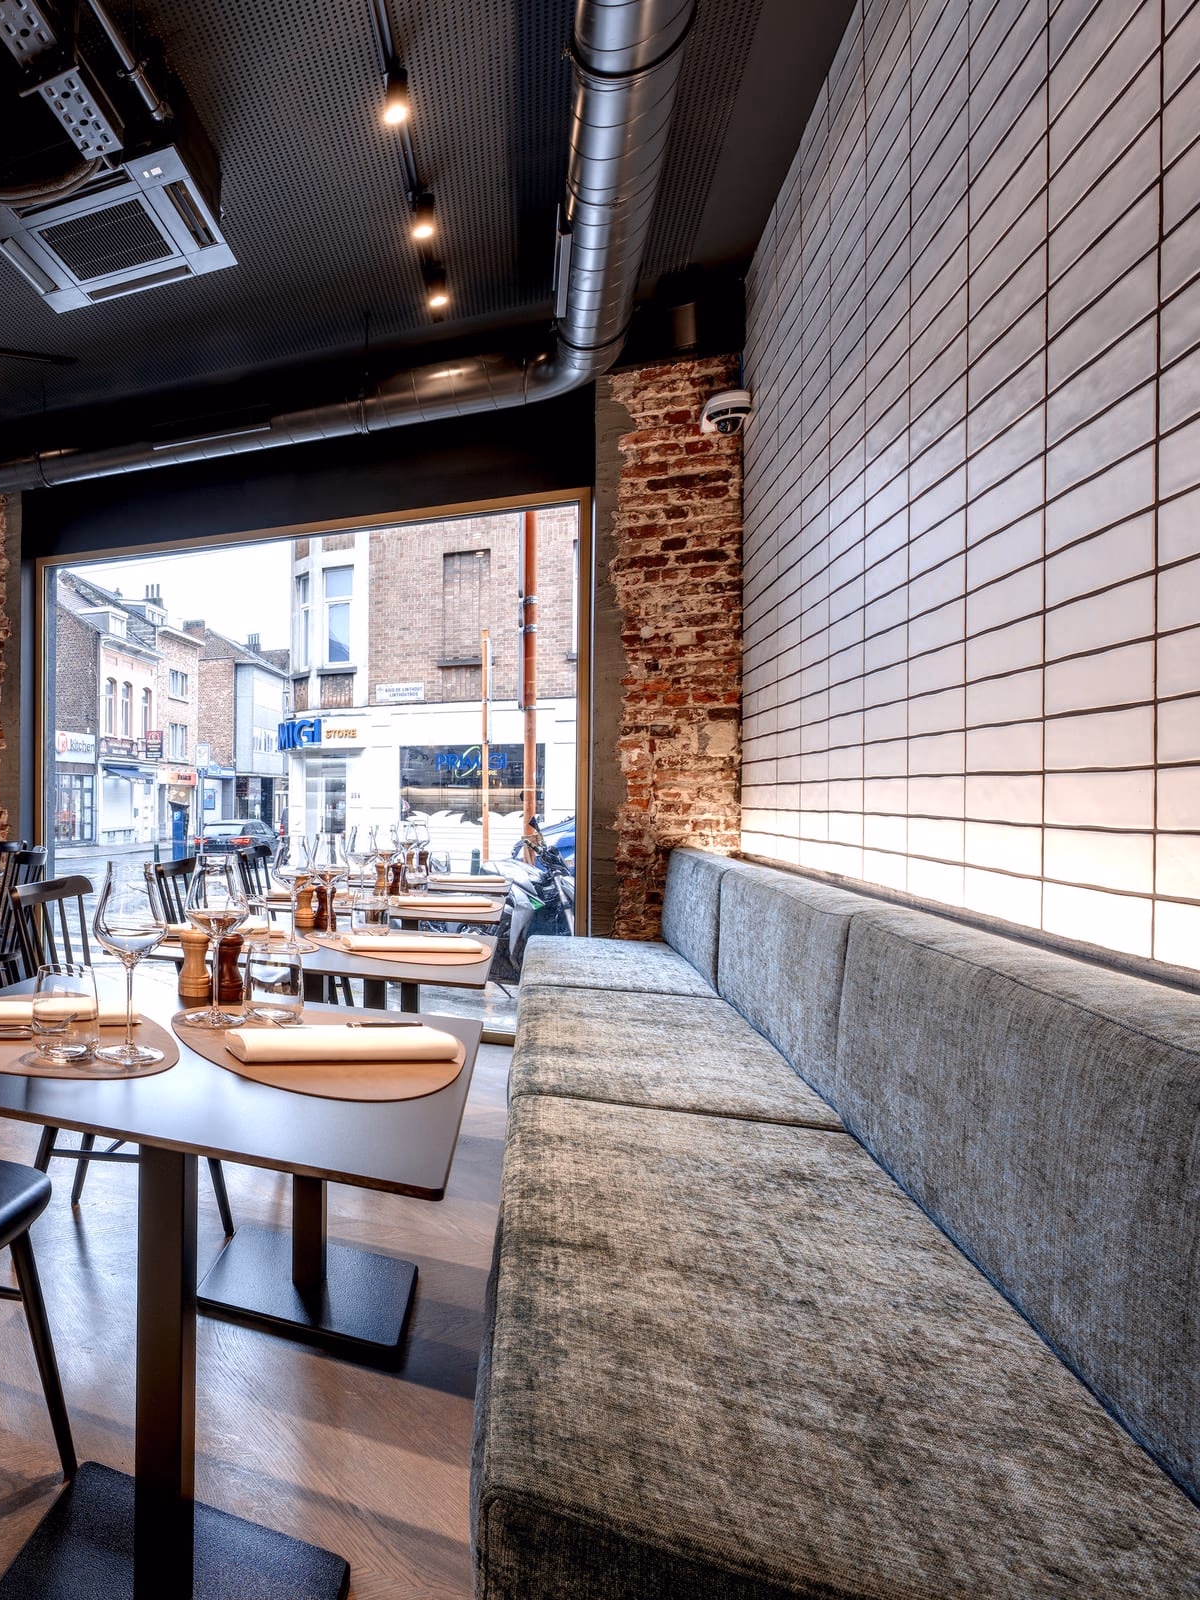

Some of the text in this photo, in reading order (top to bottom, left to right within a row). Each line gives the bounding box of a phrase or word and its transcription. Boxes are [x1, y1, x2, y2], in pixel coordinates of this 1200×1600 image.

[278, 719, 322, 752] MIGI
[325, 728, 357, 739] STORE
[435, 752, 507, 771] PRIMGI
